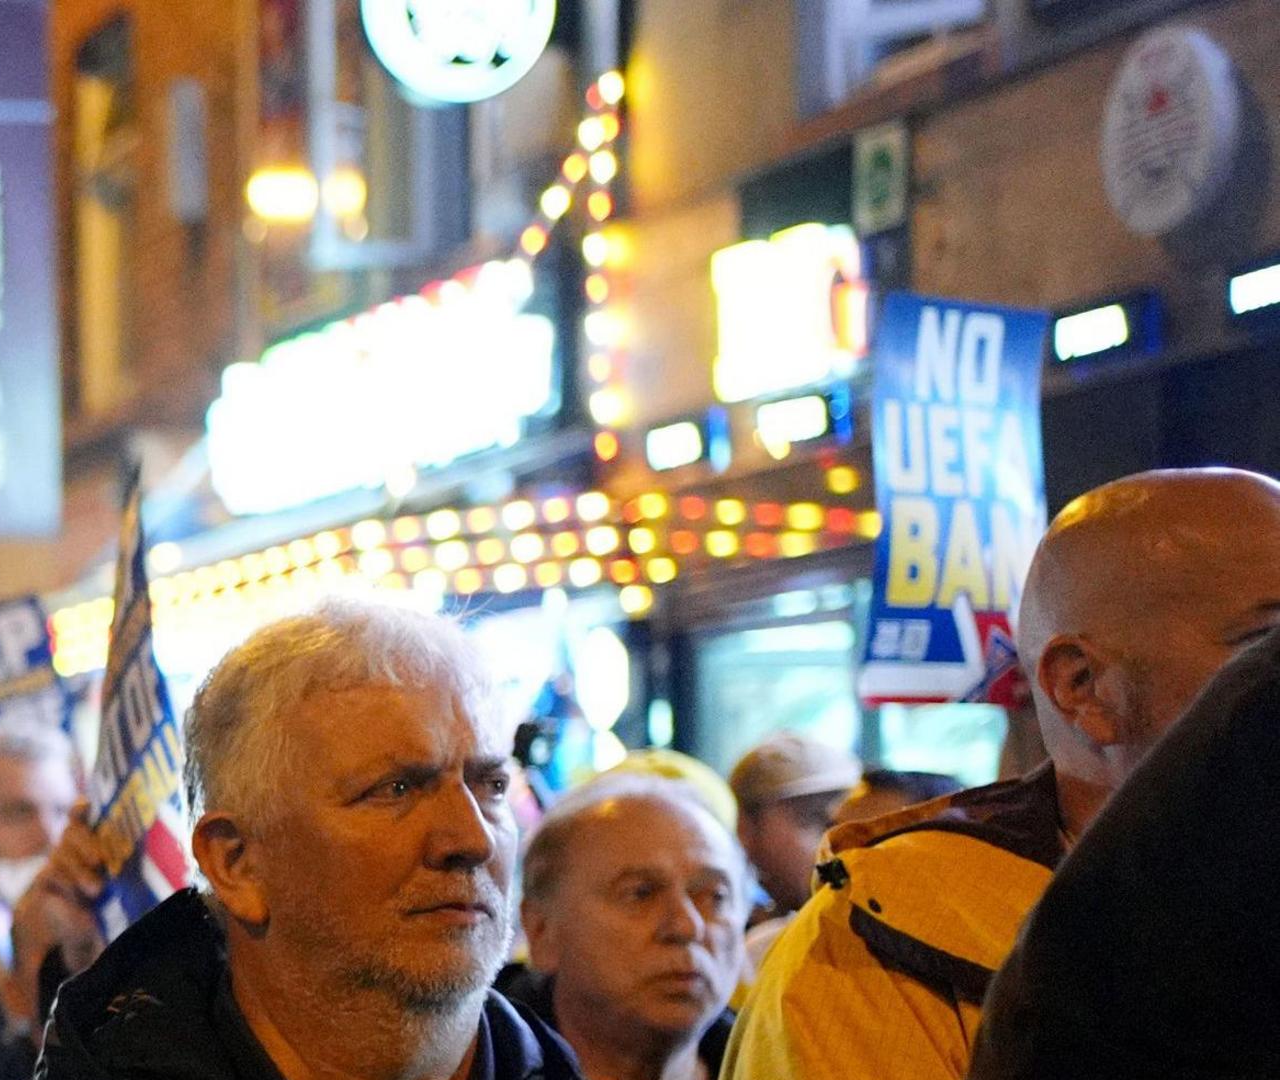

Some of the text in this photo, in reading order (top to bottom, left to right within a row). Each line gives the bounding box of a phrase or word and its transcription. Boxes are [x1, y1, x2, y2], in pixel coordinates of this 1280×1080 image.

[914, 305, 1005, 406] NO
[883, 398, 1040, 515] UEFA
[885, 495, 1042, 613] BAN
